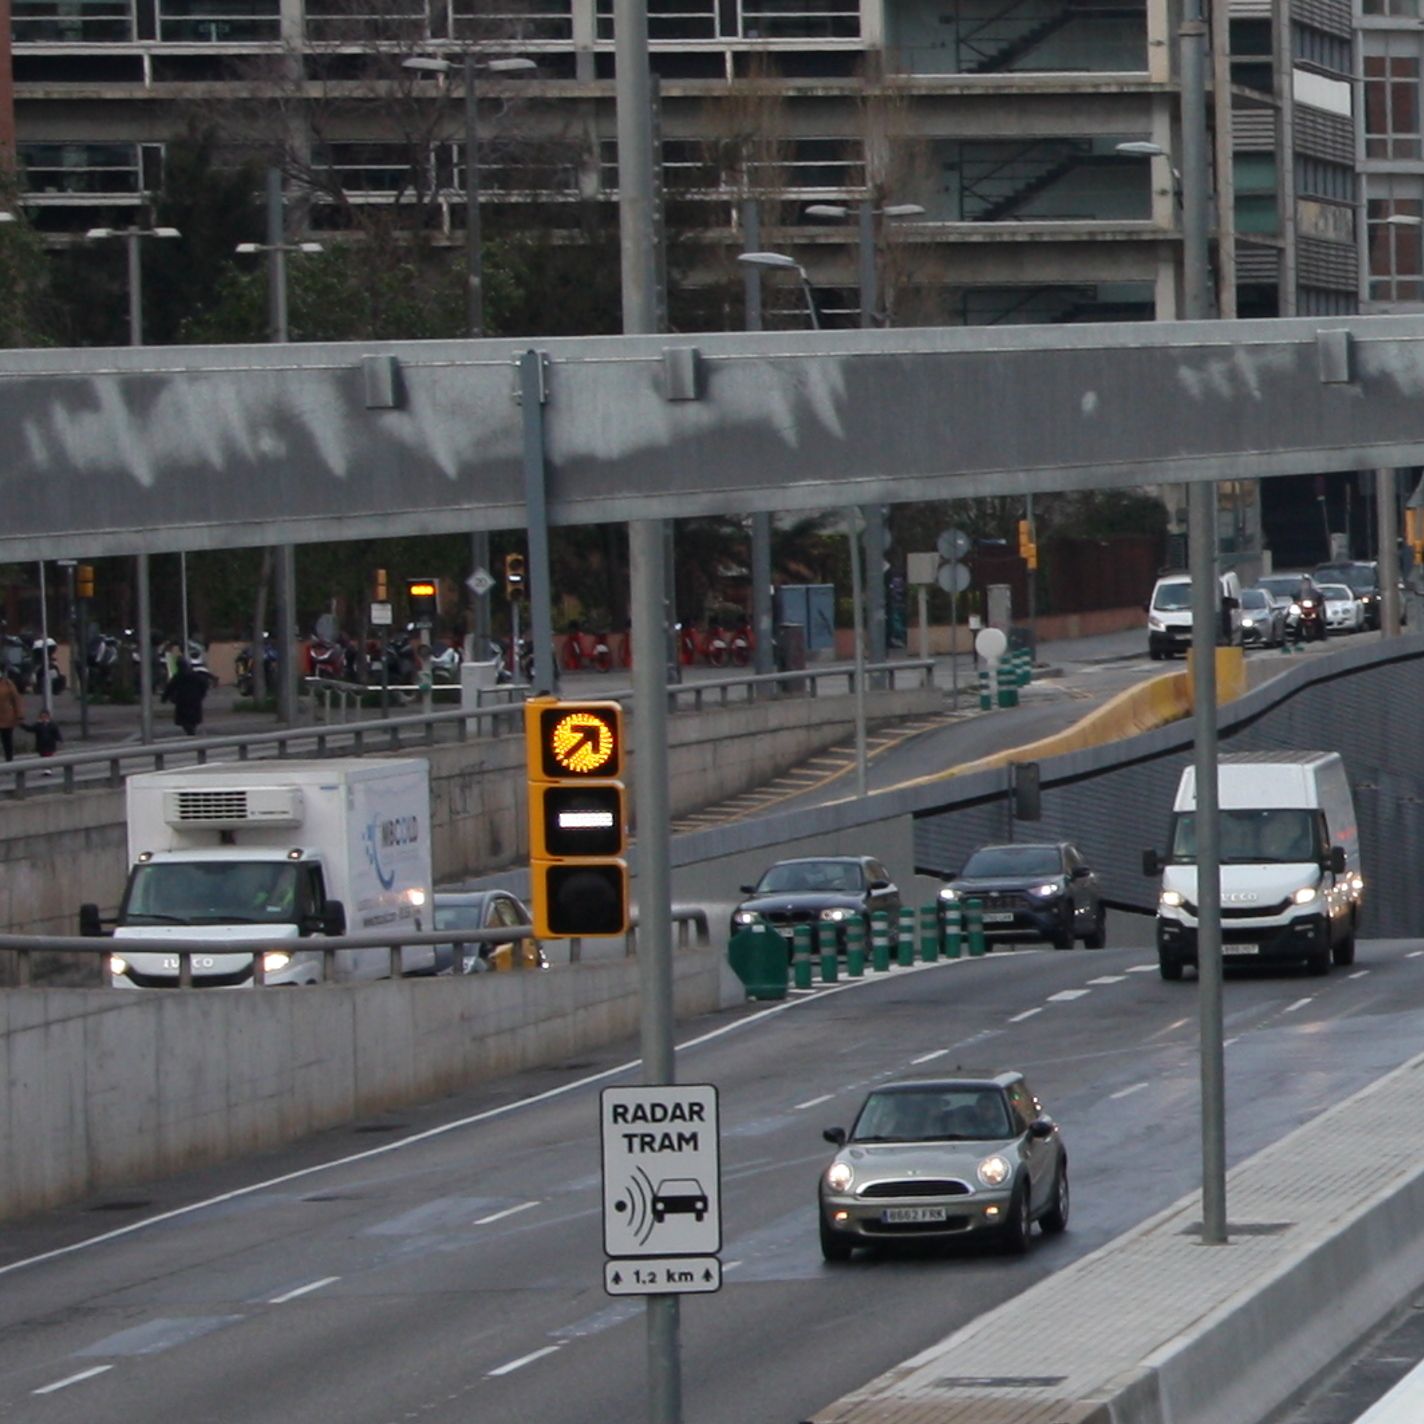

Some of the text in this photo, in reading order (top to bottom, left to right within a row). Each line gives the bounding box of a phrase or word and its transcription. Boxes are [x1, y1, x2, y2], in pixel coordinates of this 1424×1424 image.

[162, 957, 214, 969] IVCO
[612, 1102, 705, 1124] RADAR
[622, 1132, 699, 1153] TRAM
[633, 1269, 694, 1285] 1.2 km
